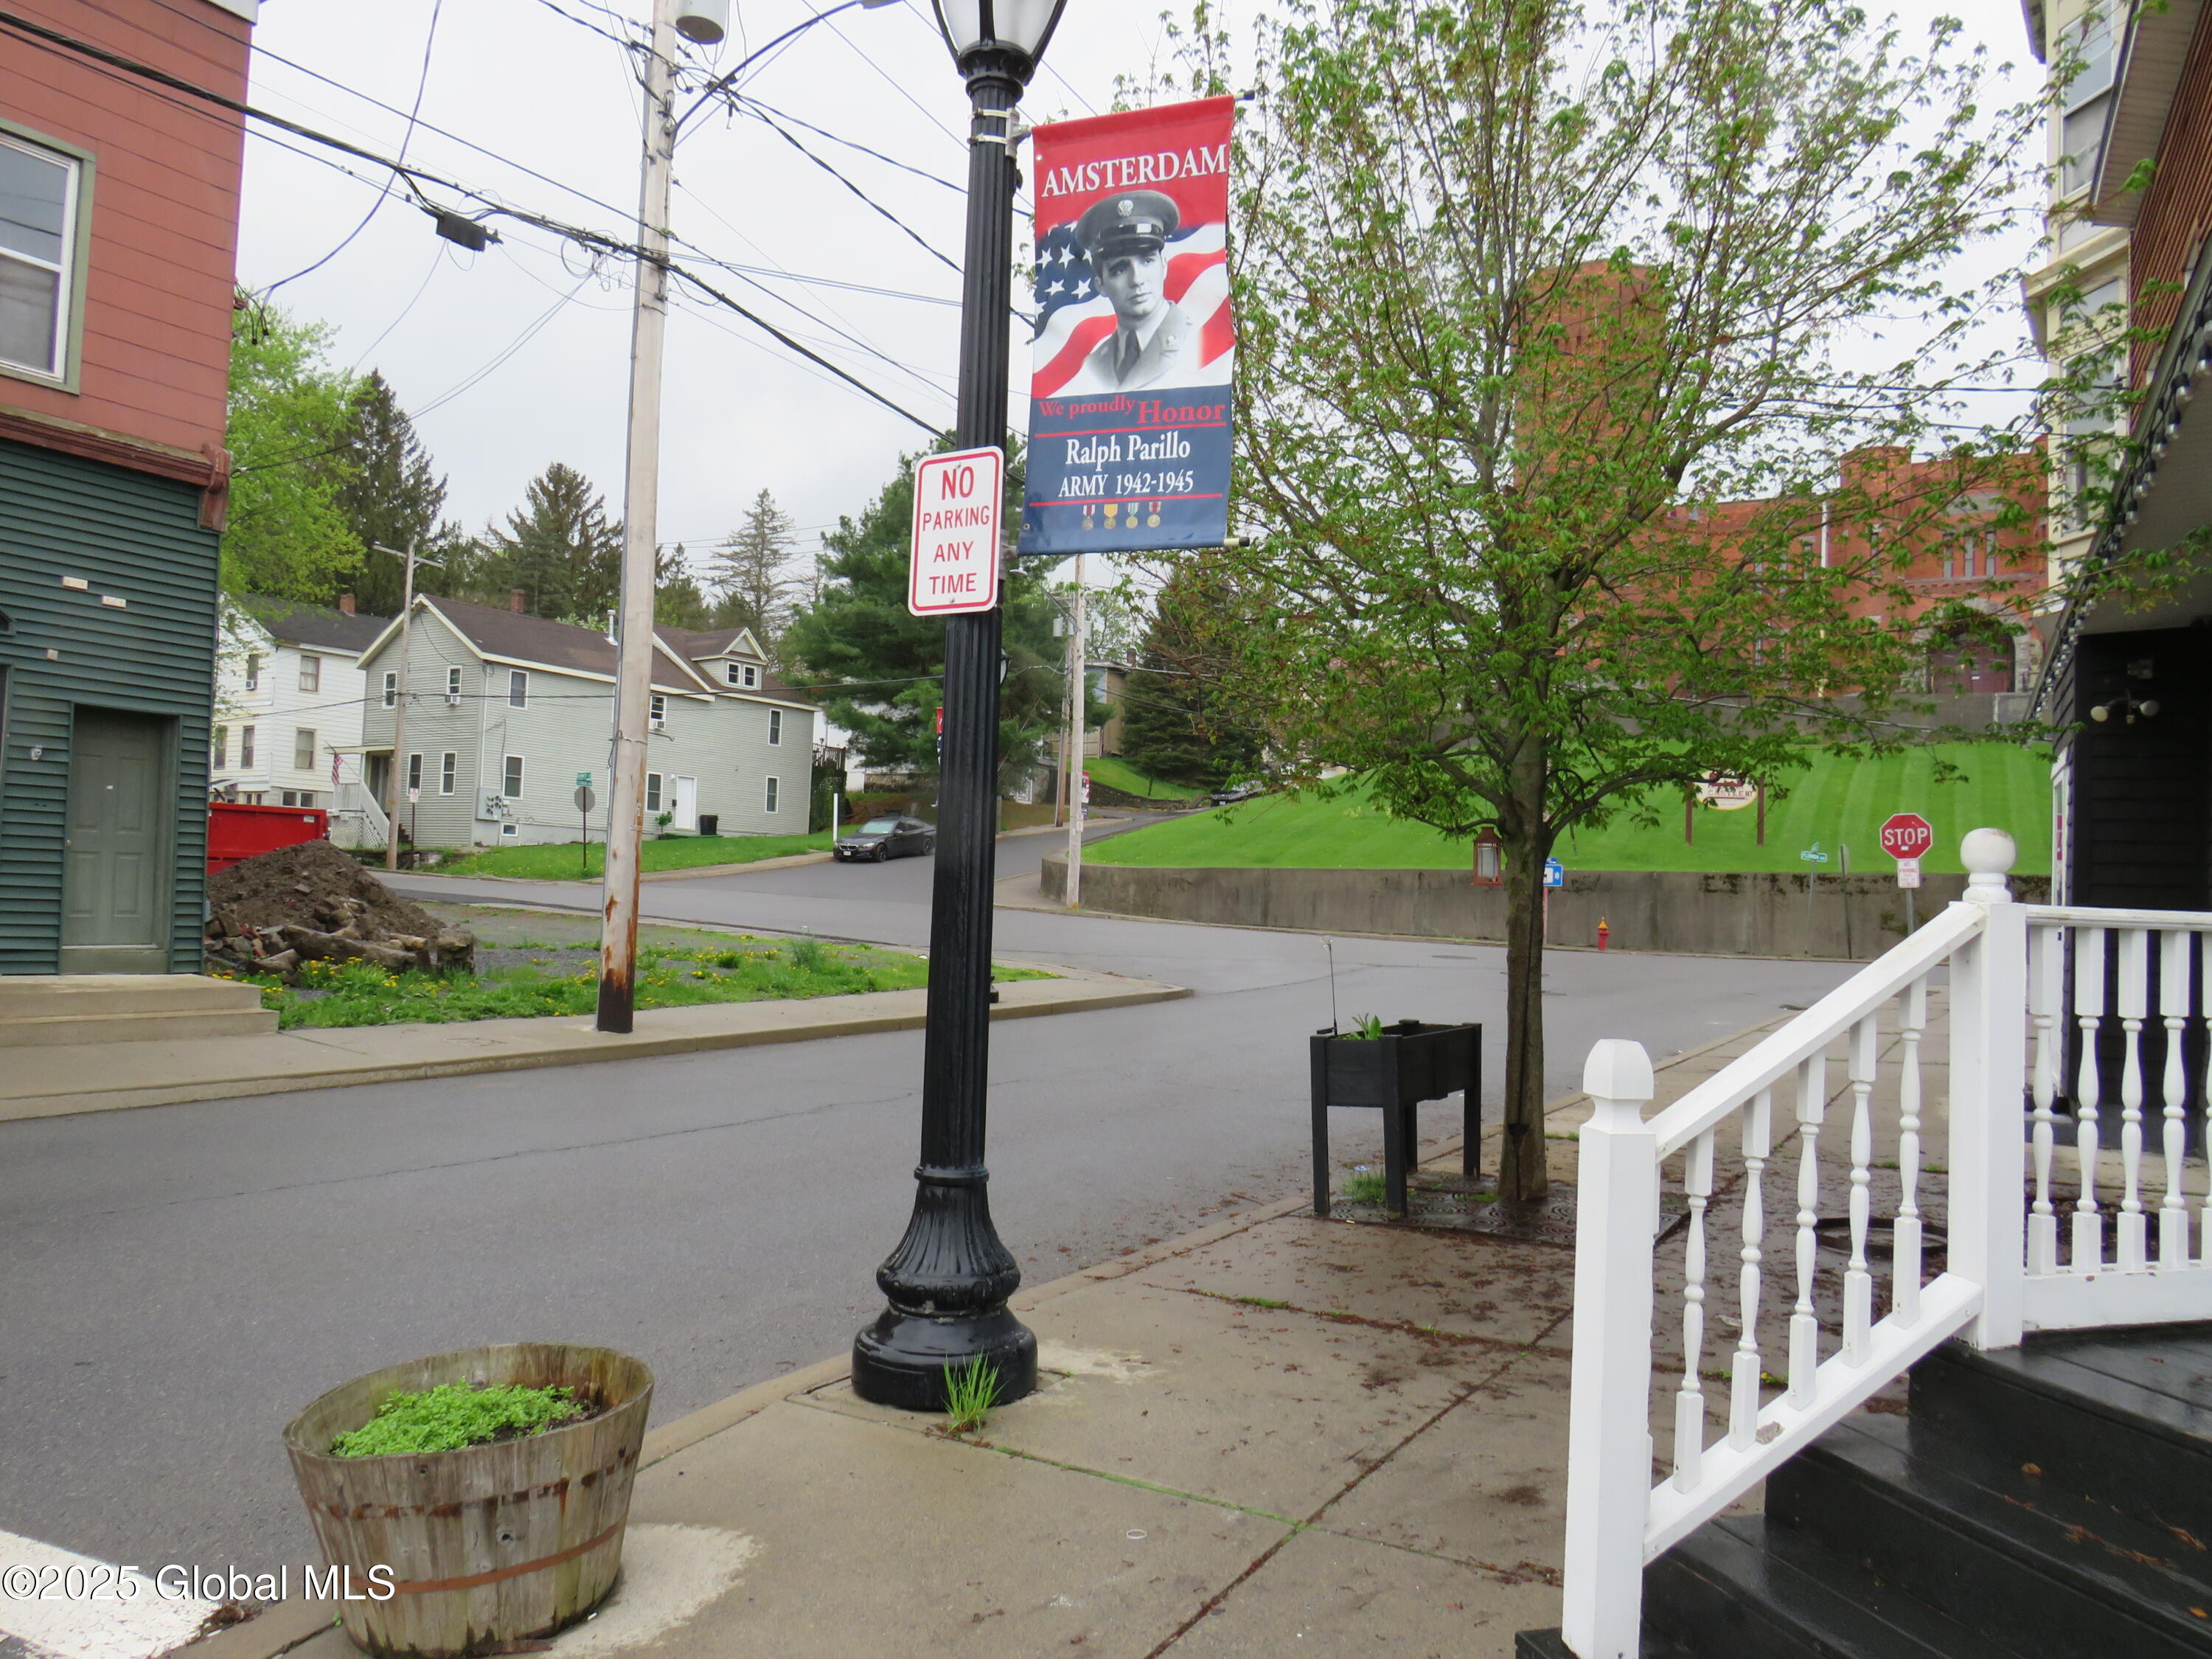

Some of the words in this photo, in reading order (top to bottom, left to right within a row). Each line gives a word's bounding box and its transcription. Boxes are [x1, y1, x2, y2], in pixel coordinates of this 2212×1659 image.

[1041, 144, 1227, 198] AMSTERDAM
[1038, 400, 1064, 417] We
[1069, 395, 1136, 419] proudly
[1137, 400, 1226, 424] Honor
[1065, 434, 1121, 472] Ralph
[1127, 430, 1191, 461] Parillo
[942, 466, 974, 501] NO
[1058, 474, 1108, 498] ARMY
[1116, 469, 1194, 496] 1942-1945
[922, 505, 990, 532] PARKING
[933, 540, 974, 563] ANY
[929, 572, 977, 595] TIME
[1884, 827, 1928, 846] STOP
